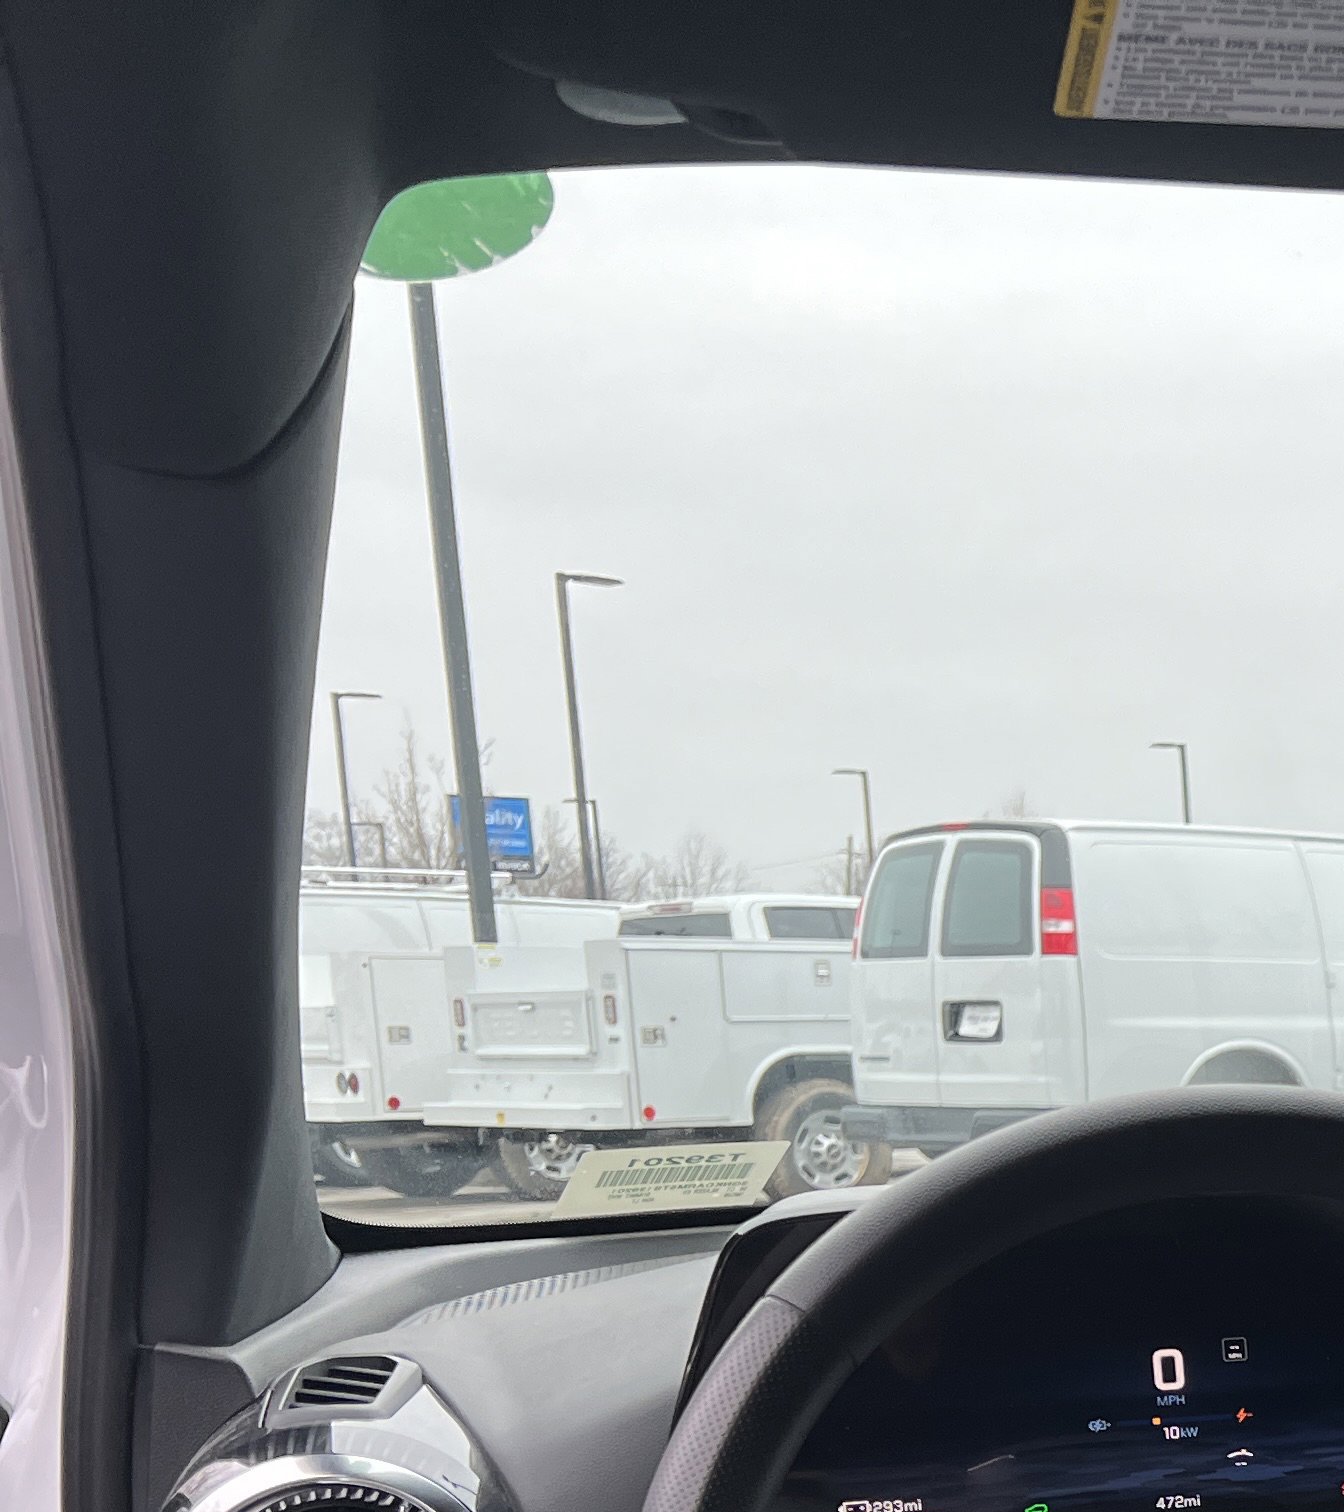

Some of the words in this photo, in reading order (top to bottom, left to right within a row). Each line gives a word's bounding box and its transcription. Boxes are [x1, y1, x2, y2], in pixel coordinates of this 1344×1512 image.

[1152, 1348, 1185, 1391] 0
[1156, 1394, 1186, 1407] MPH
[1163, 1426, 1199, 1440] 10kW
[1155, 1495, 1201, 1510] 472mi
